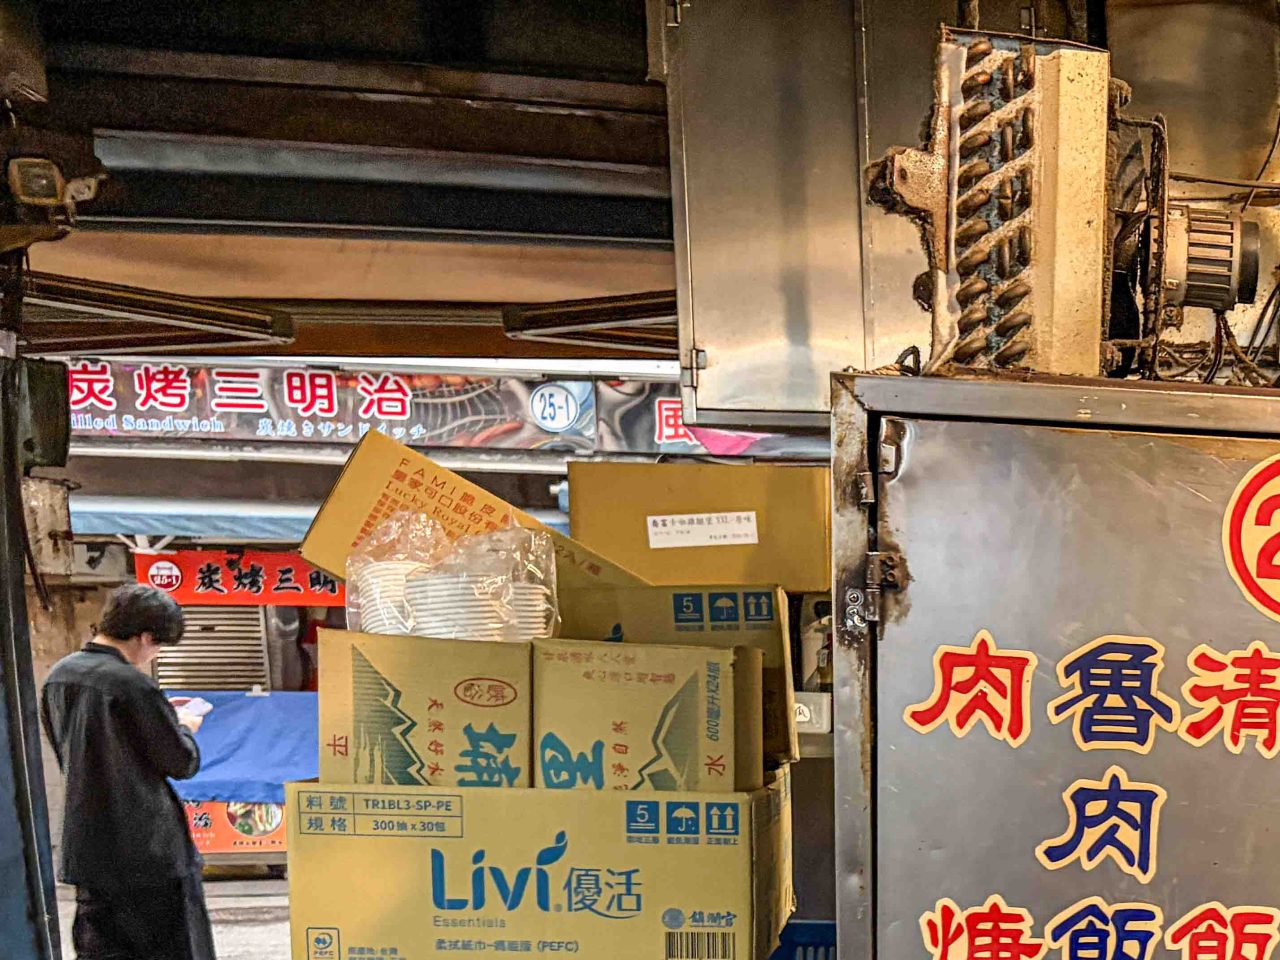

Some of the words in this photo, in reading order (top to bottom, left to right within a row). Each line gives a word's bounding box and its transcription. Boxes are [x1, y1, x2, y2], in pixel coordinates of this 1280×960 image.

[69, 361, 413, 420] 炭烤三明治
[539, 393, 570, 421] 25-1
[71, 412, 117, 430] illed
[122, 414, 225, 433] Sandwich
[386, 480, 428, 509] Lucky
[433, 506, 472, 534] Royal
[682, 597, 694, 613] 5
[326, 733, 348, 757] 平
[427, 696, 445, 777] 天然好水
[541, 732, 605, 790] 里
[704, 755, 727, 777] 水
[305, 796, 347, 811] 料號
[363, 797, 453, 812] TR1BL3-SP-PE
[636, 805, 649, 823] 5
[306, 816, 347, 832] 規格
[431, 830, 568, 912] Livi
[562, 866, 643, 914] 優活
[432, 915, 507, 928] Essentials
[537, 940, 579, 953] (PEFC)
